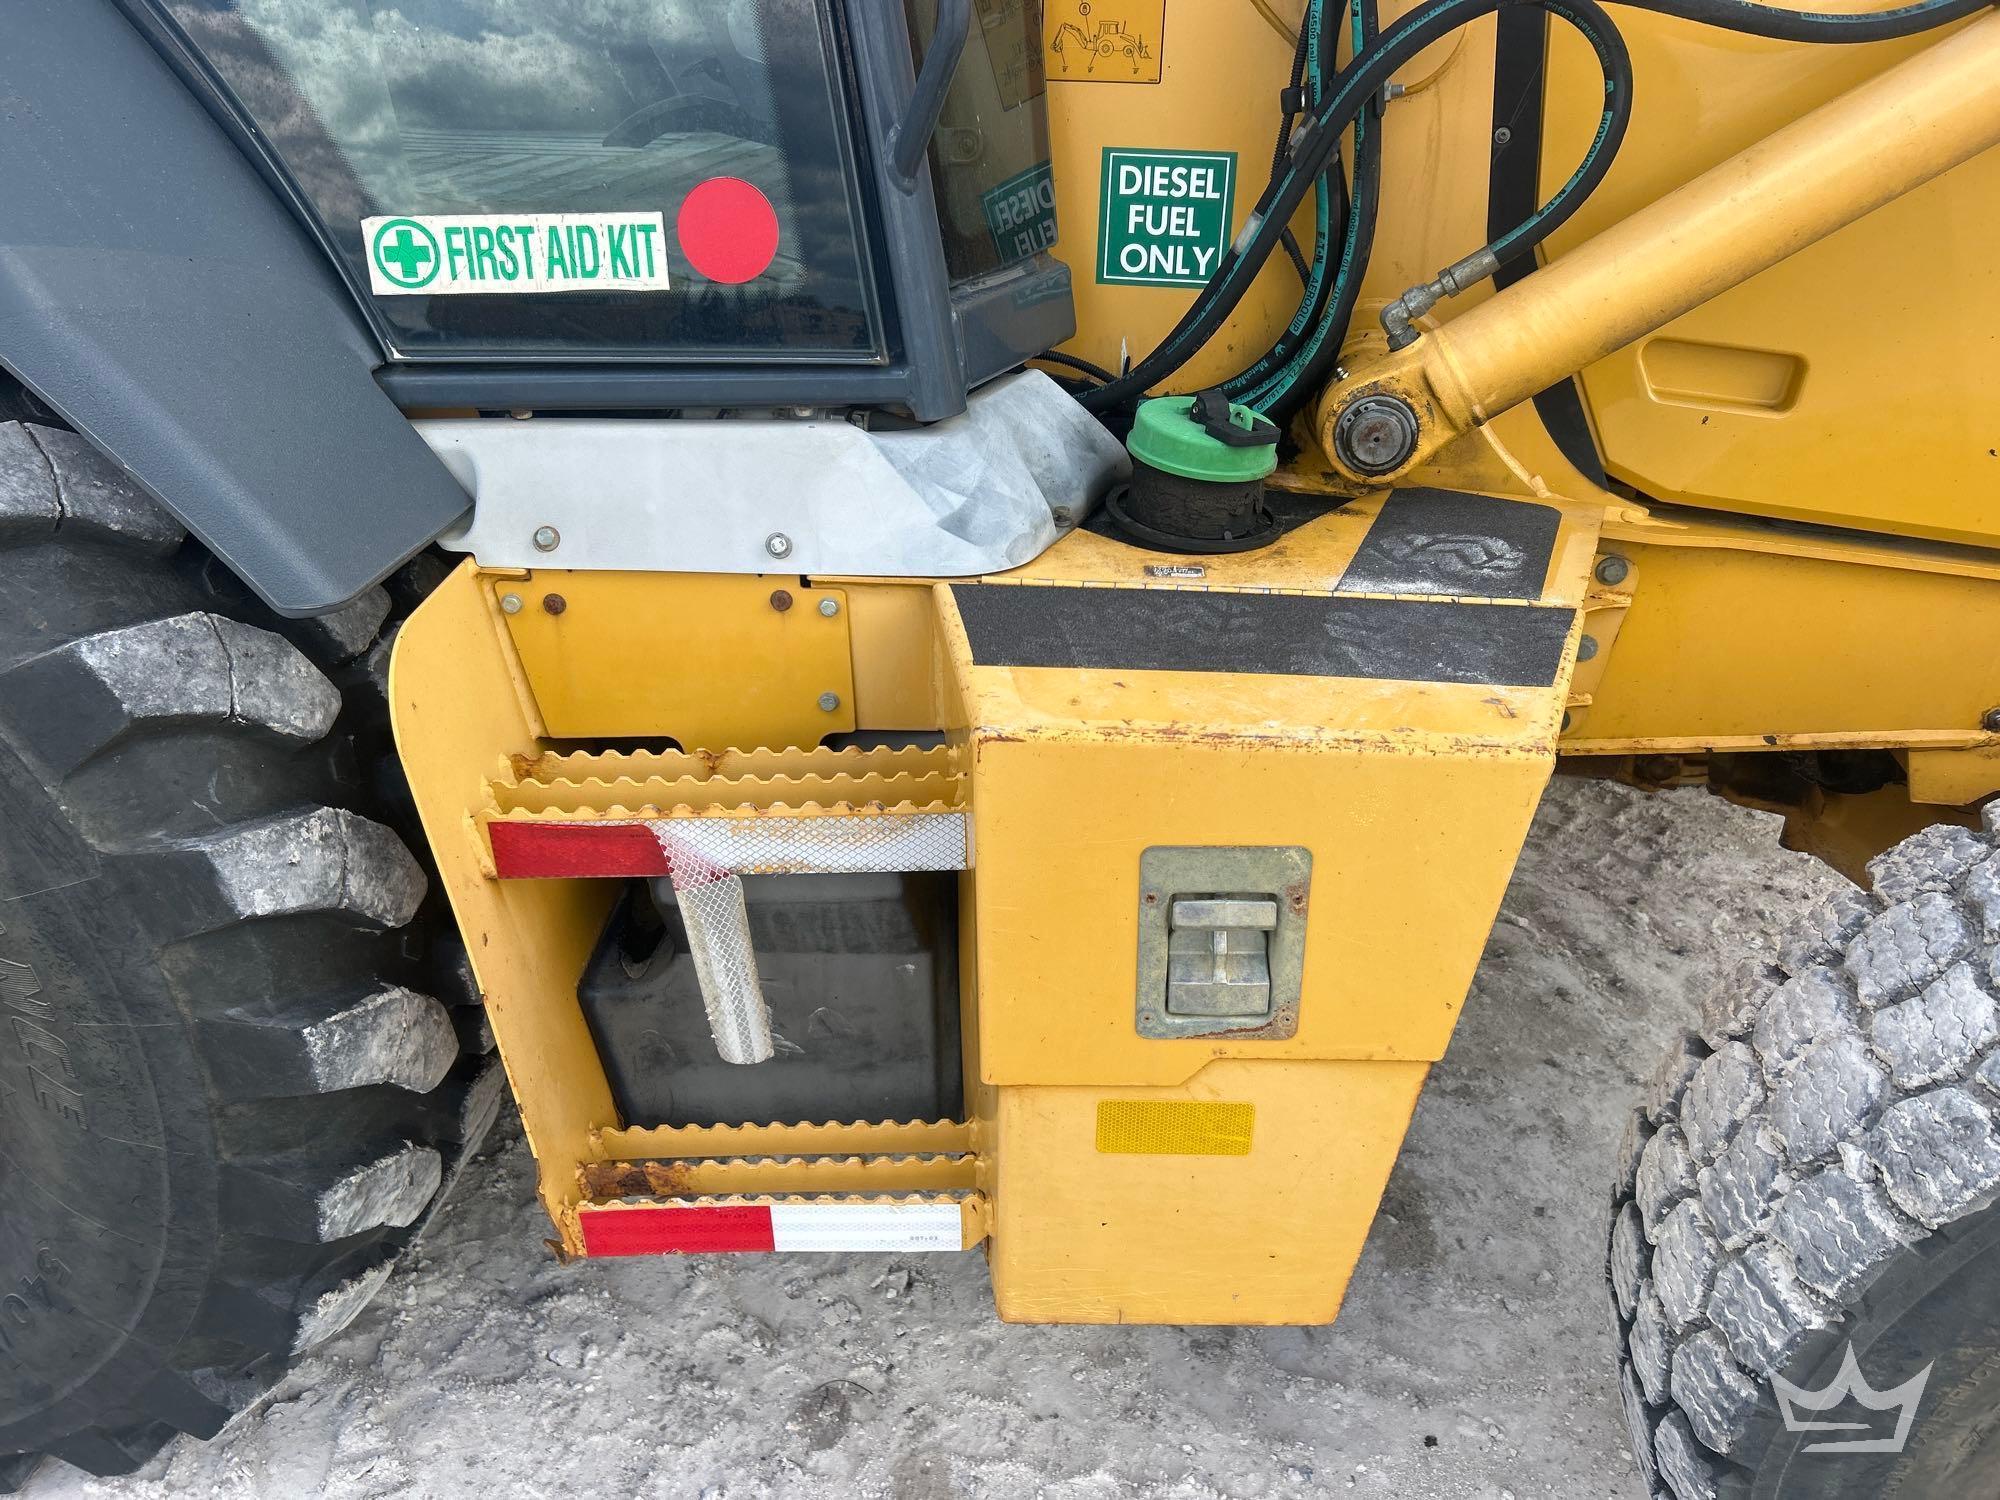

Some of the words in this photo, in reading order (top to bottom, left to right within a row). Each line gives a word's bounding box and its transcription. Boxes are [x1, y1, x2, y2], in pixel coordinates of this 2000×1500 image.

[1119, 164, 1221, 199] DIESEL
[1127, 204, 1201, 237] FUEL
[444, 225, 535, 281] FIRST
[547, 224, 599, 280] AID
[607, 223, 657, 278] KIT
[1120, 243, 1216, 276] ONLY
[1291, 275, 1319, 334] AEROQUIP
[1223, 358, 1269, 391] MatchMate
